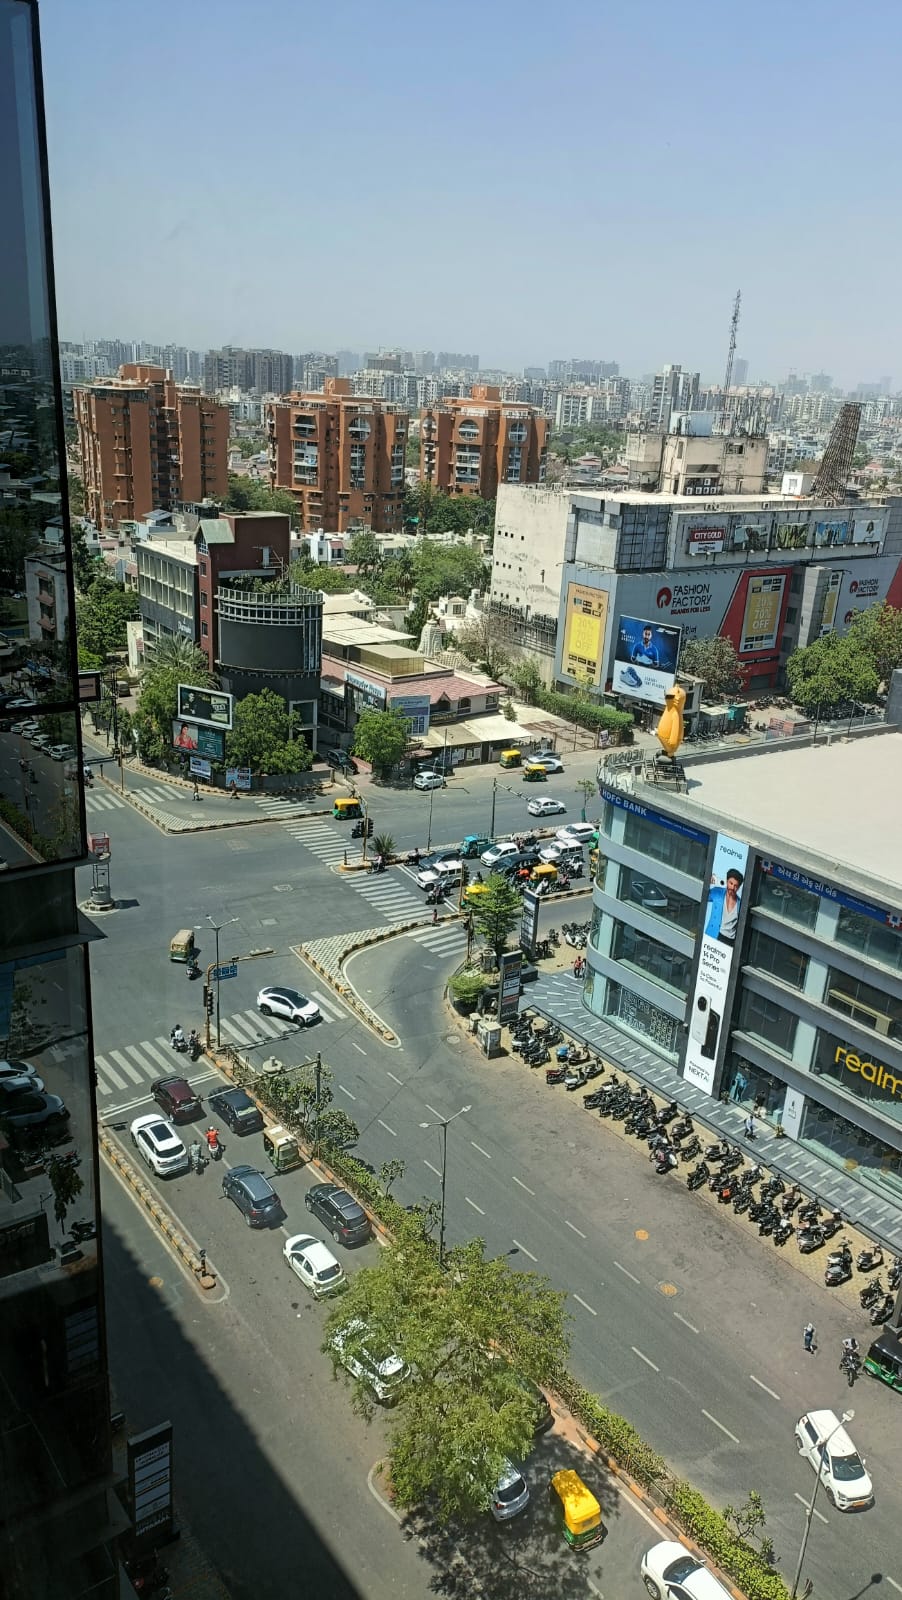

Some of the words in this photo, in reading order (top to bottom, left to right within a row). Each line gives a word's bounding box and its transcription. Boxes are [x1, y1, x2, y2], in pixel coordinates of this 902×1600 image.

[694, 532, 707, 540] CITY
[707, 531, 722, 539] GOLD
[673, 584, 711, 596] FASHION
[672, 595, 713, 607] FACTORY
[752, 619, 770, 630] OFF
[602, 788, 621, 805] HDFC
[623, 800, 647, 816] BANK
[720, 845, 742, 860] realme
[703, 943, 726, 959] realme
[710, 953, 720, 964] Pro
[702, 958, 720, 973] Series
